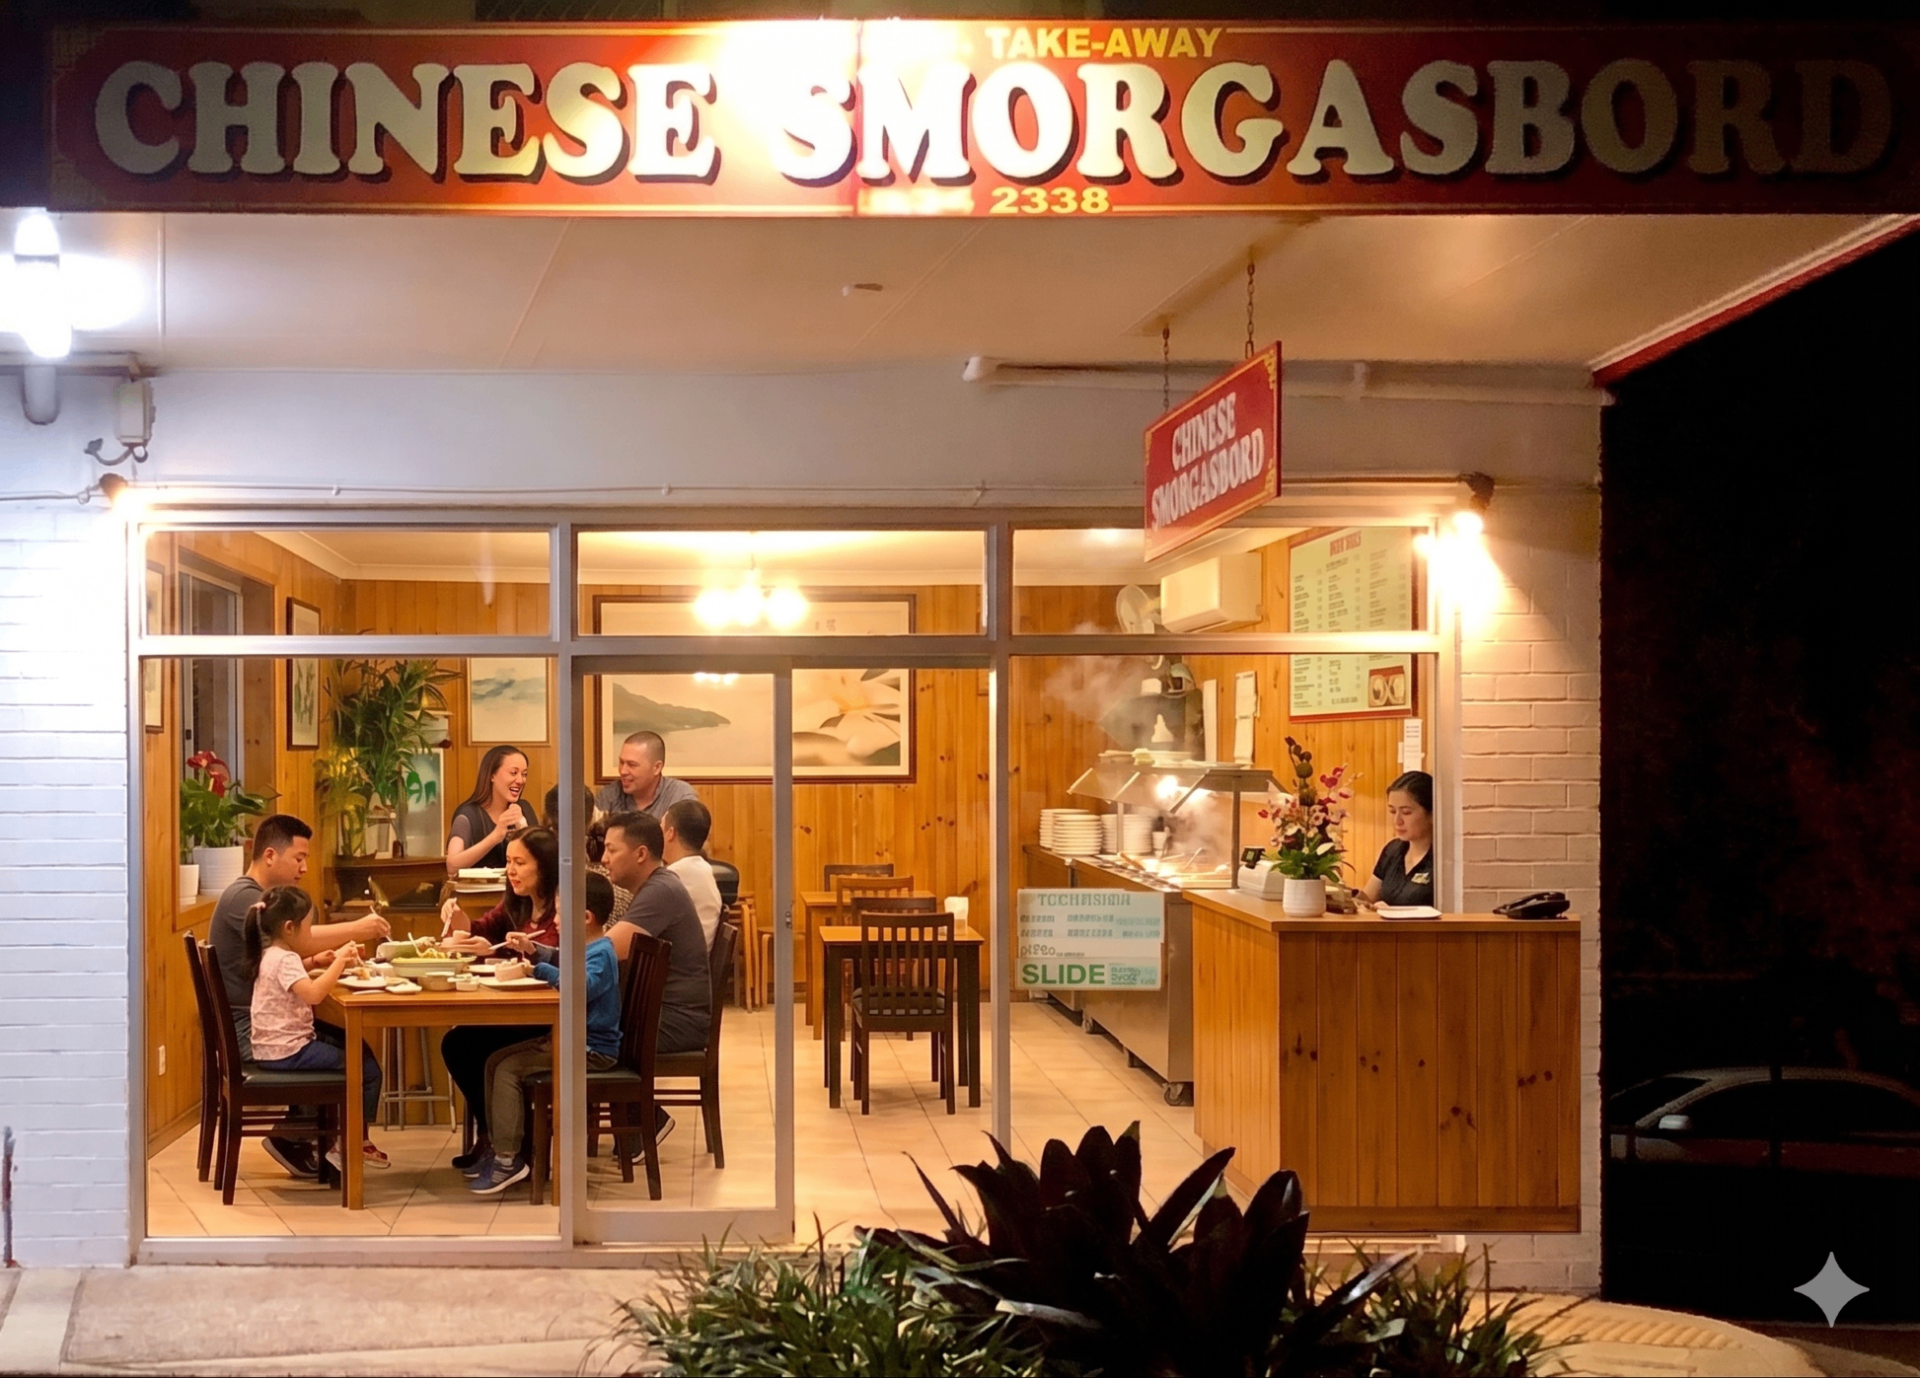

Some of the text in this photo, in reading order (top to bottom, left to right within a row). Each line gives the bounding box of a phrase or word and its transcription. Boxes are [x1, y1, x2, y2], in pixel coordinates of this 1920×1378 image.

[985, 28, 1219, 58] TAKE-AWAY
[95, 59, 1893, 182] CHINESE SMORGASBORD
[990, 186, 1109, 214] 2338
[1172, 392, 1236, 471] CHINESE
[1152, 428, 1264, 532] SMORGASBORD
[1022, 964, 1105, 985] SLIDE
